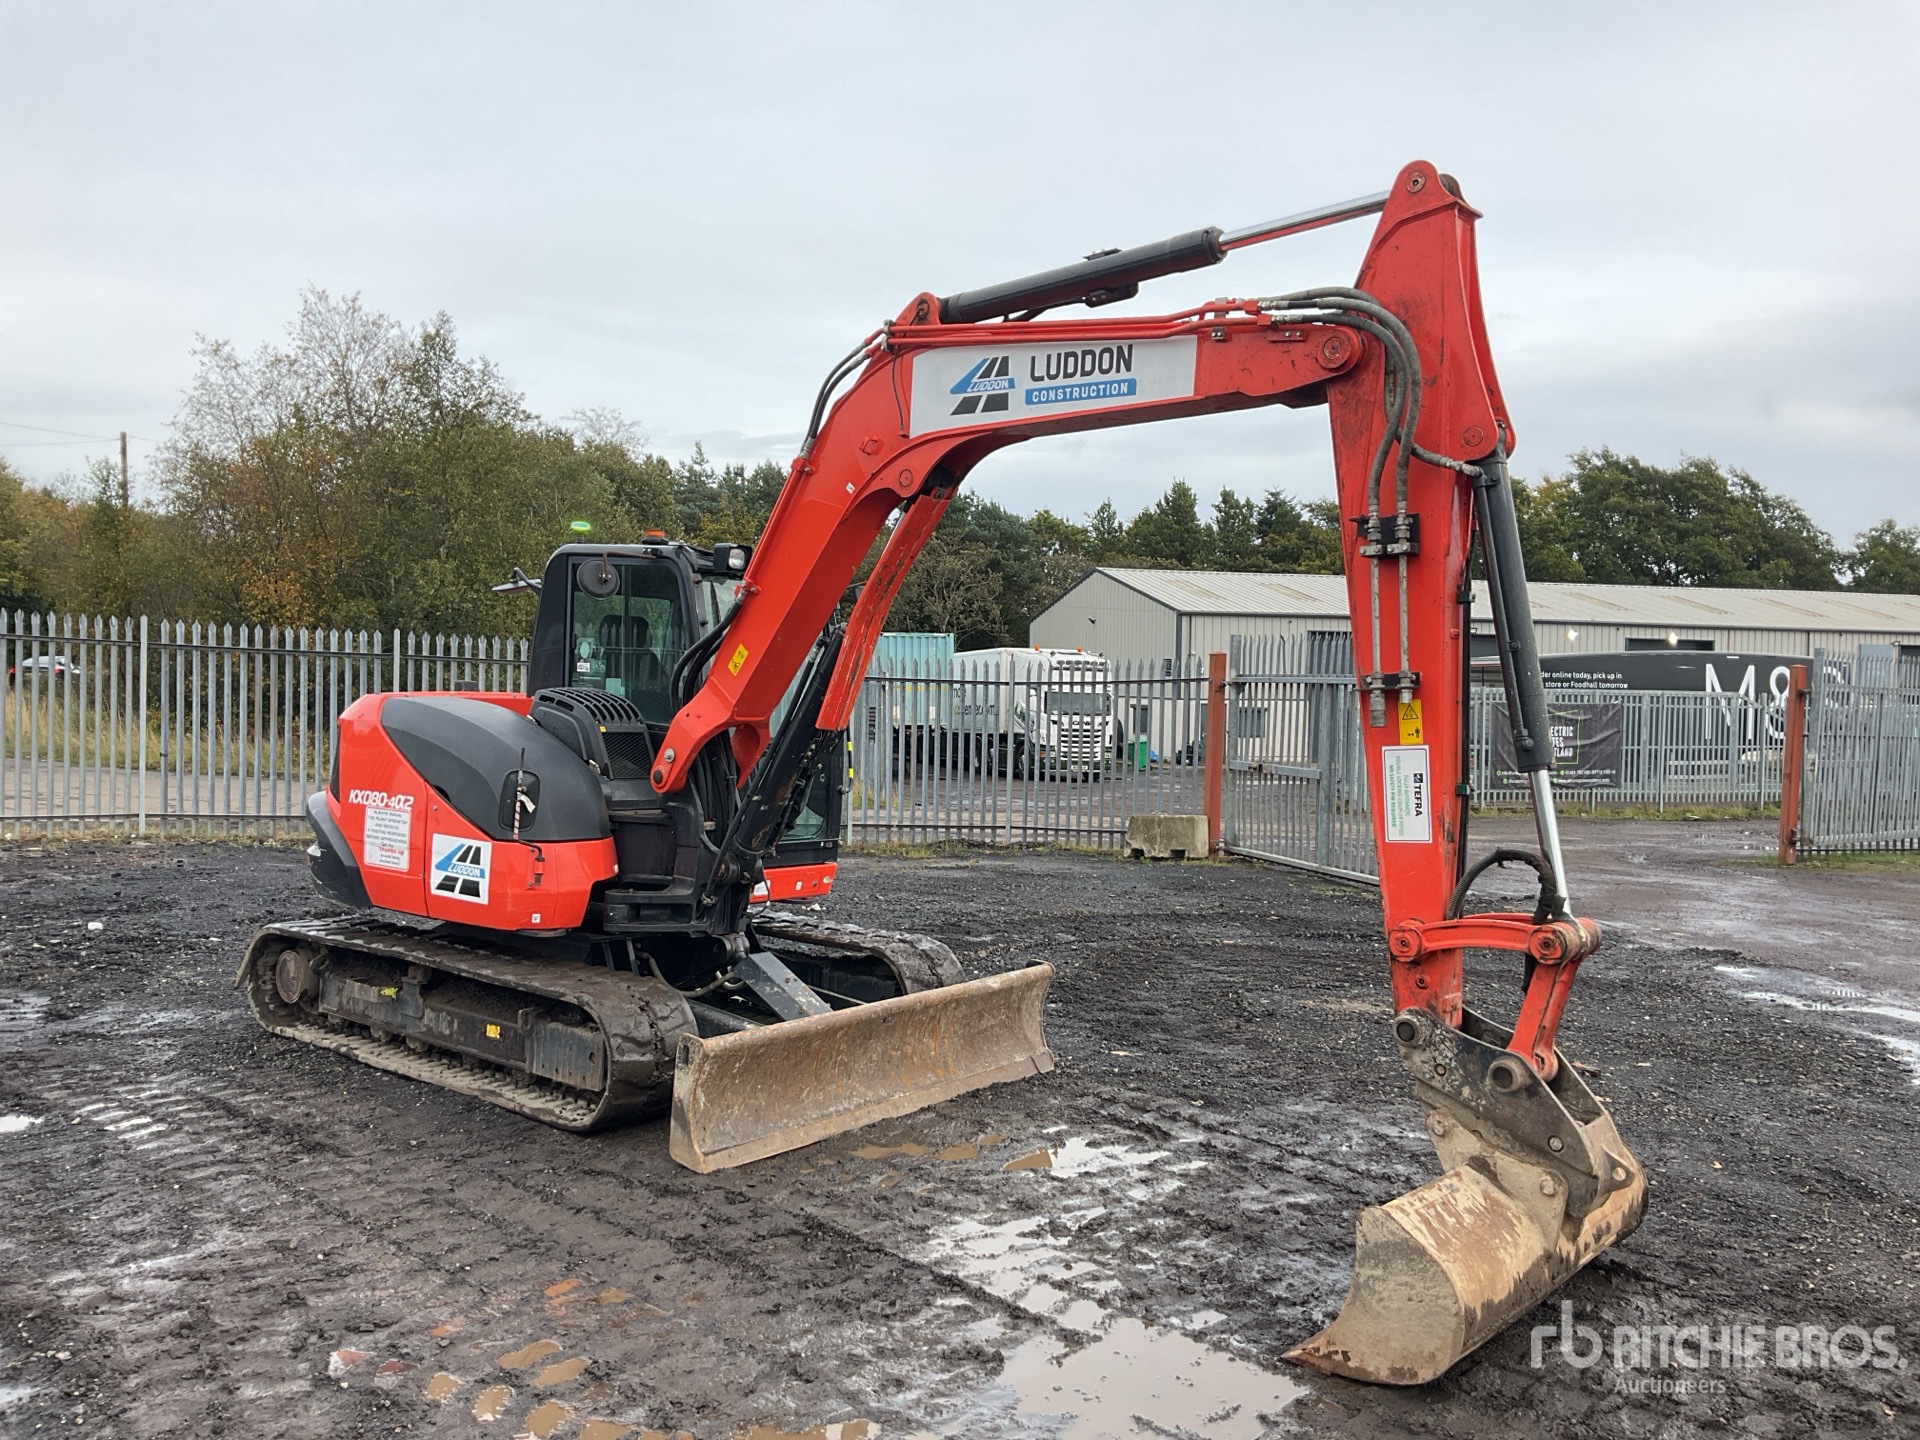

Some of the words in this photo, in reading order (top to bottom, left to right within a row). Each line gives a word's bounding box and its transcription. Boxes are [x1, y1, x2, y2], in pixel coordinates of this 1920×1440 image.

[1029, 344, 1133, 382] LUDDON
[966, 378, 1010, 393] LUDDON
[1032, 382, 1128, 402] CONSTRUCTION
[1572, 671, 1592, 680] today,
[1550, 726, 1574, 737] ECTRIC
[1551, 736, 1564, 747] TES
[1553, 747, 1573, 757] TLAND
[1389, 764, 1395, 773] NO
[1413, 784, 1423, 817] TEFRA
[448, 864, 480, 877] LUDDON
